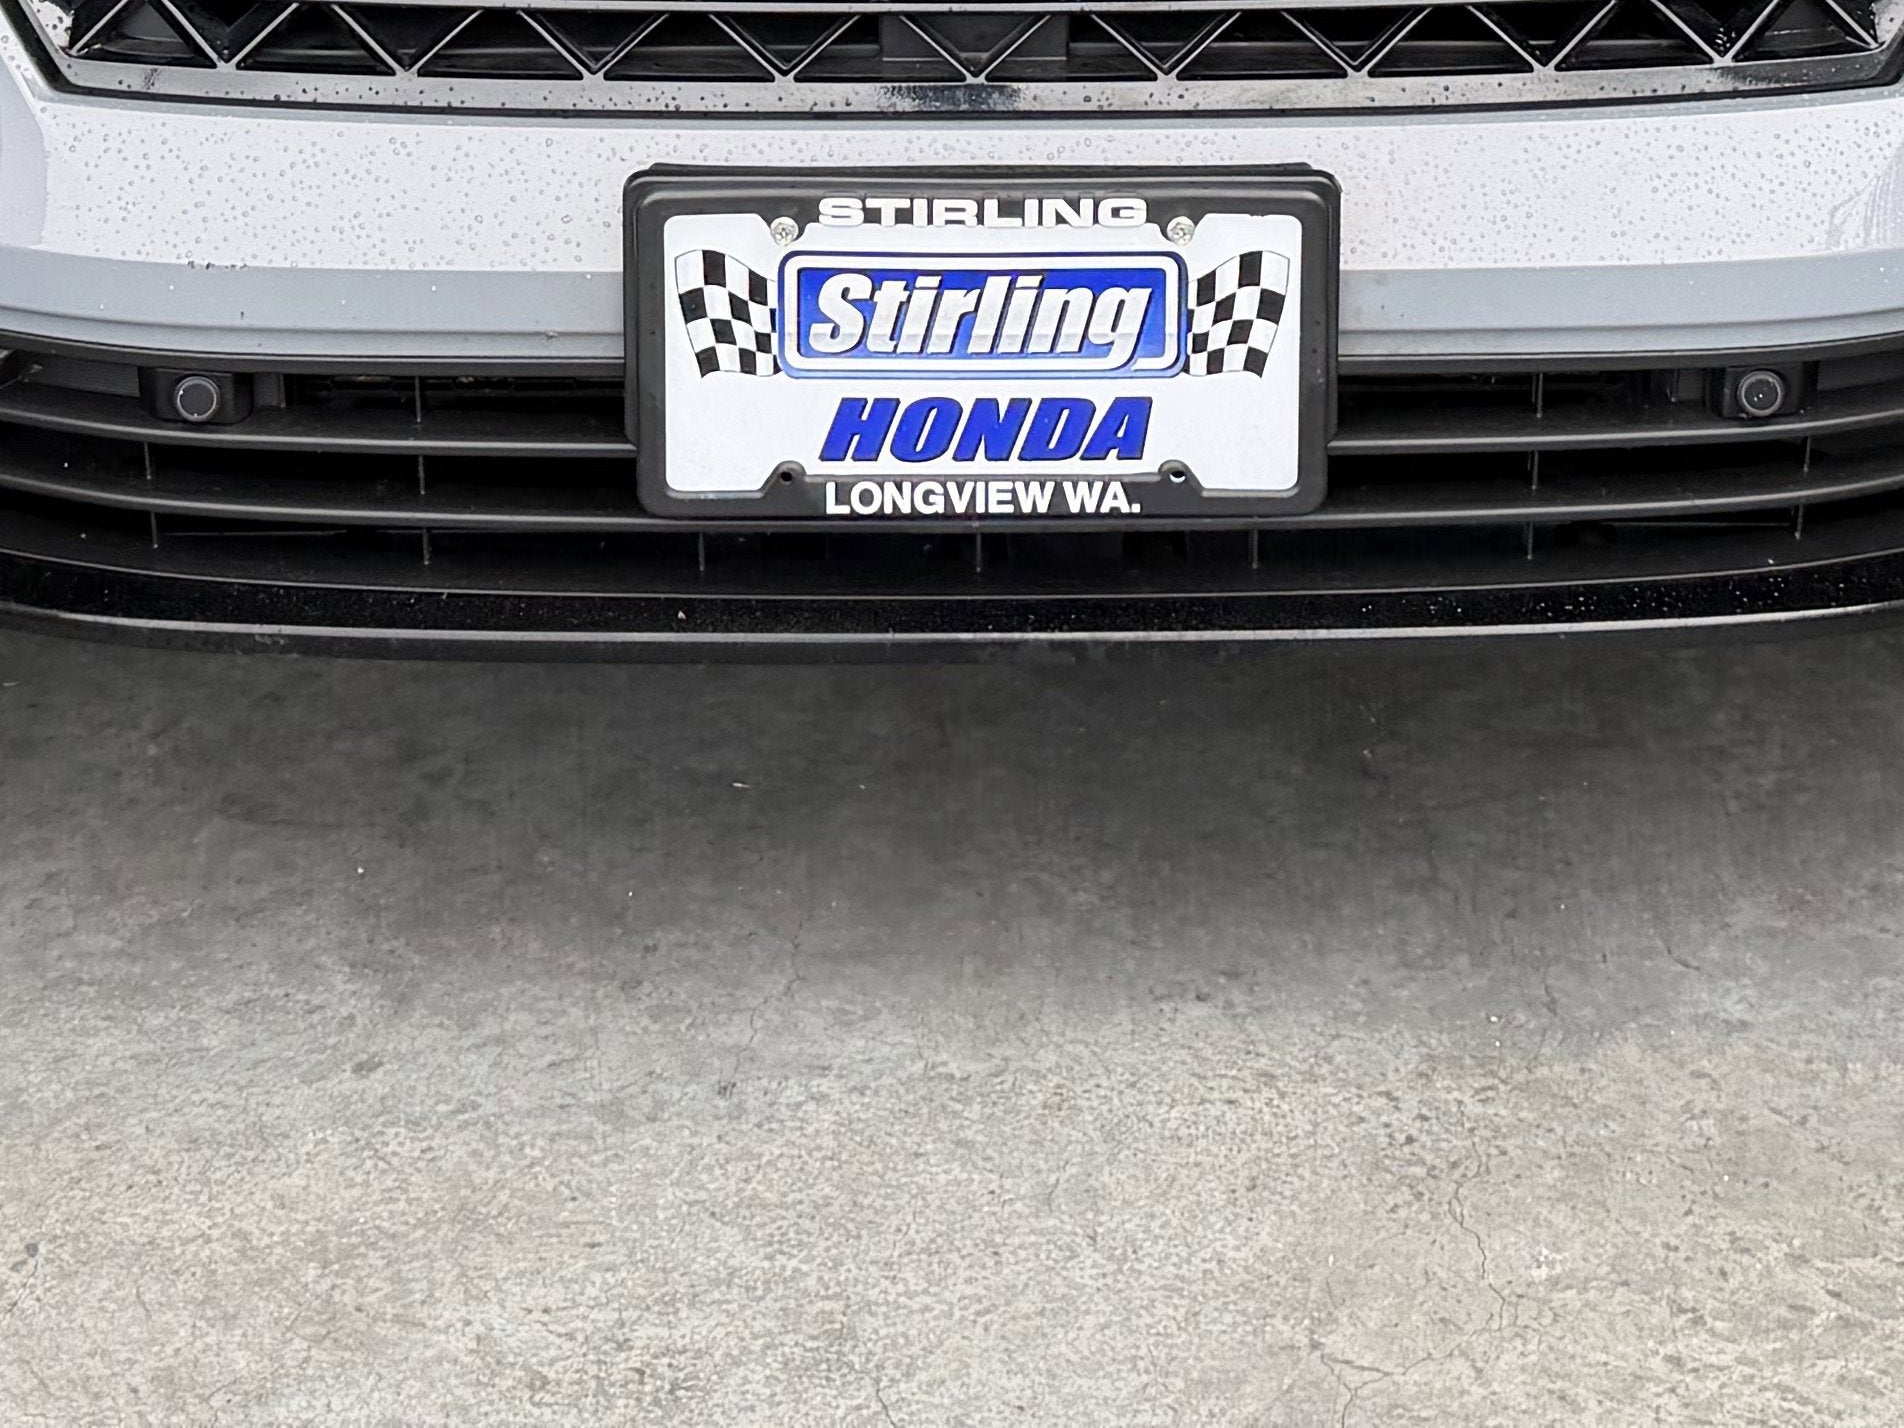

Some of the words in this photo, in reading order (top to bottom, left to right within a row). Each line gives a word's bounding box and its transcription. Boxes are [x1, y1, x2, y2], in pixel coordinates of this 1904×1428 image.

[816, 197, 1149, 228] STIRLING
[807, 273, 1153, 370] Stirling
[817, 396, 1154, 463] HONDA
[825, 481, 1058, 515] LONGVIEW
[1062, 481, 1142, 515] WA.
